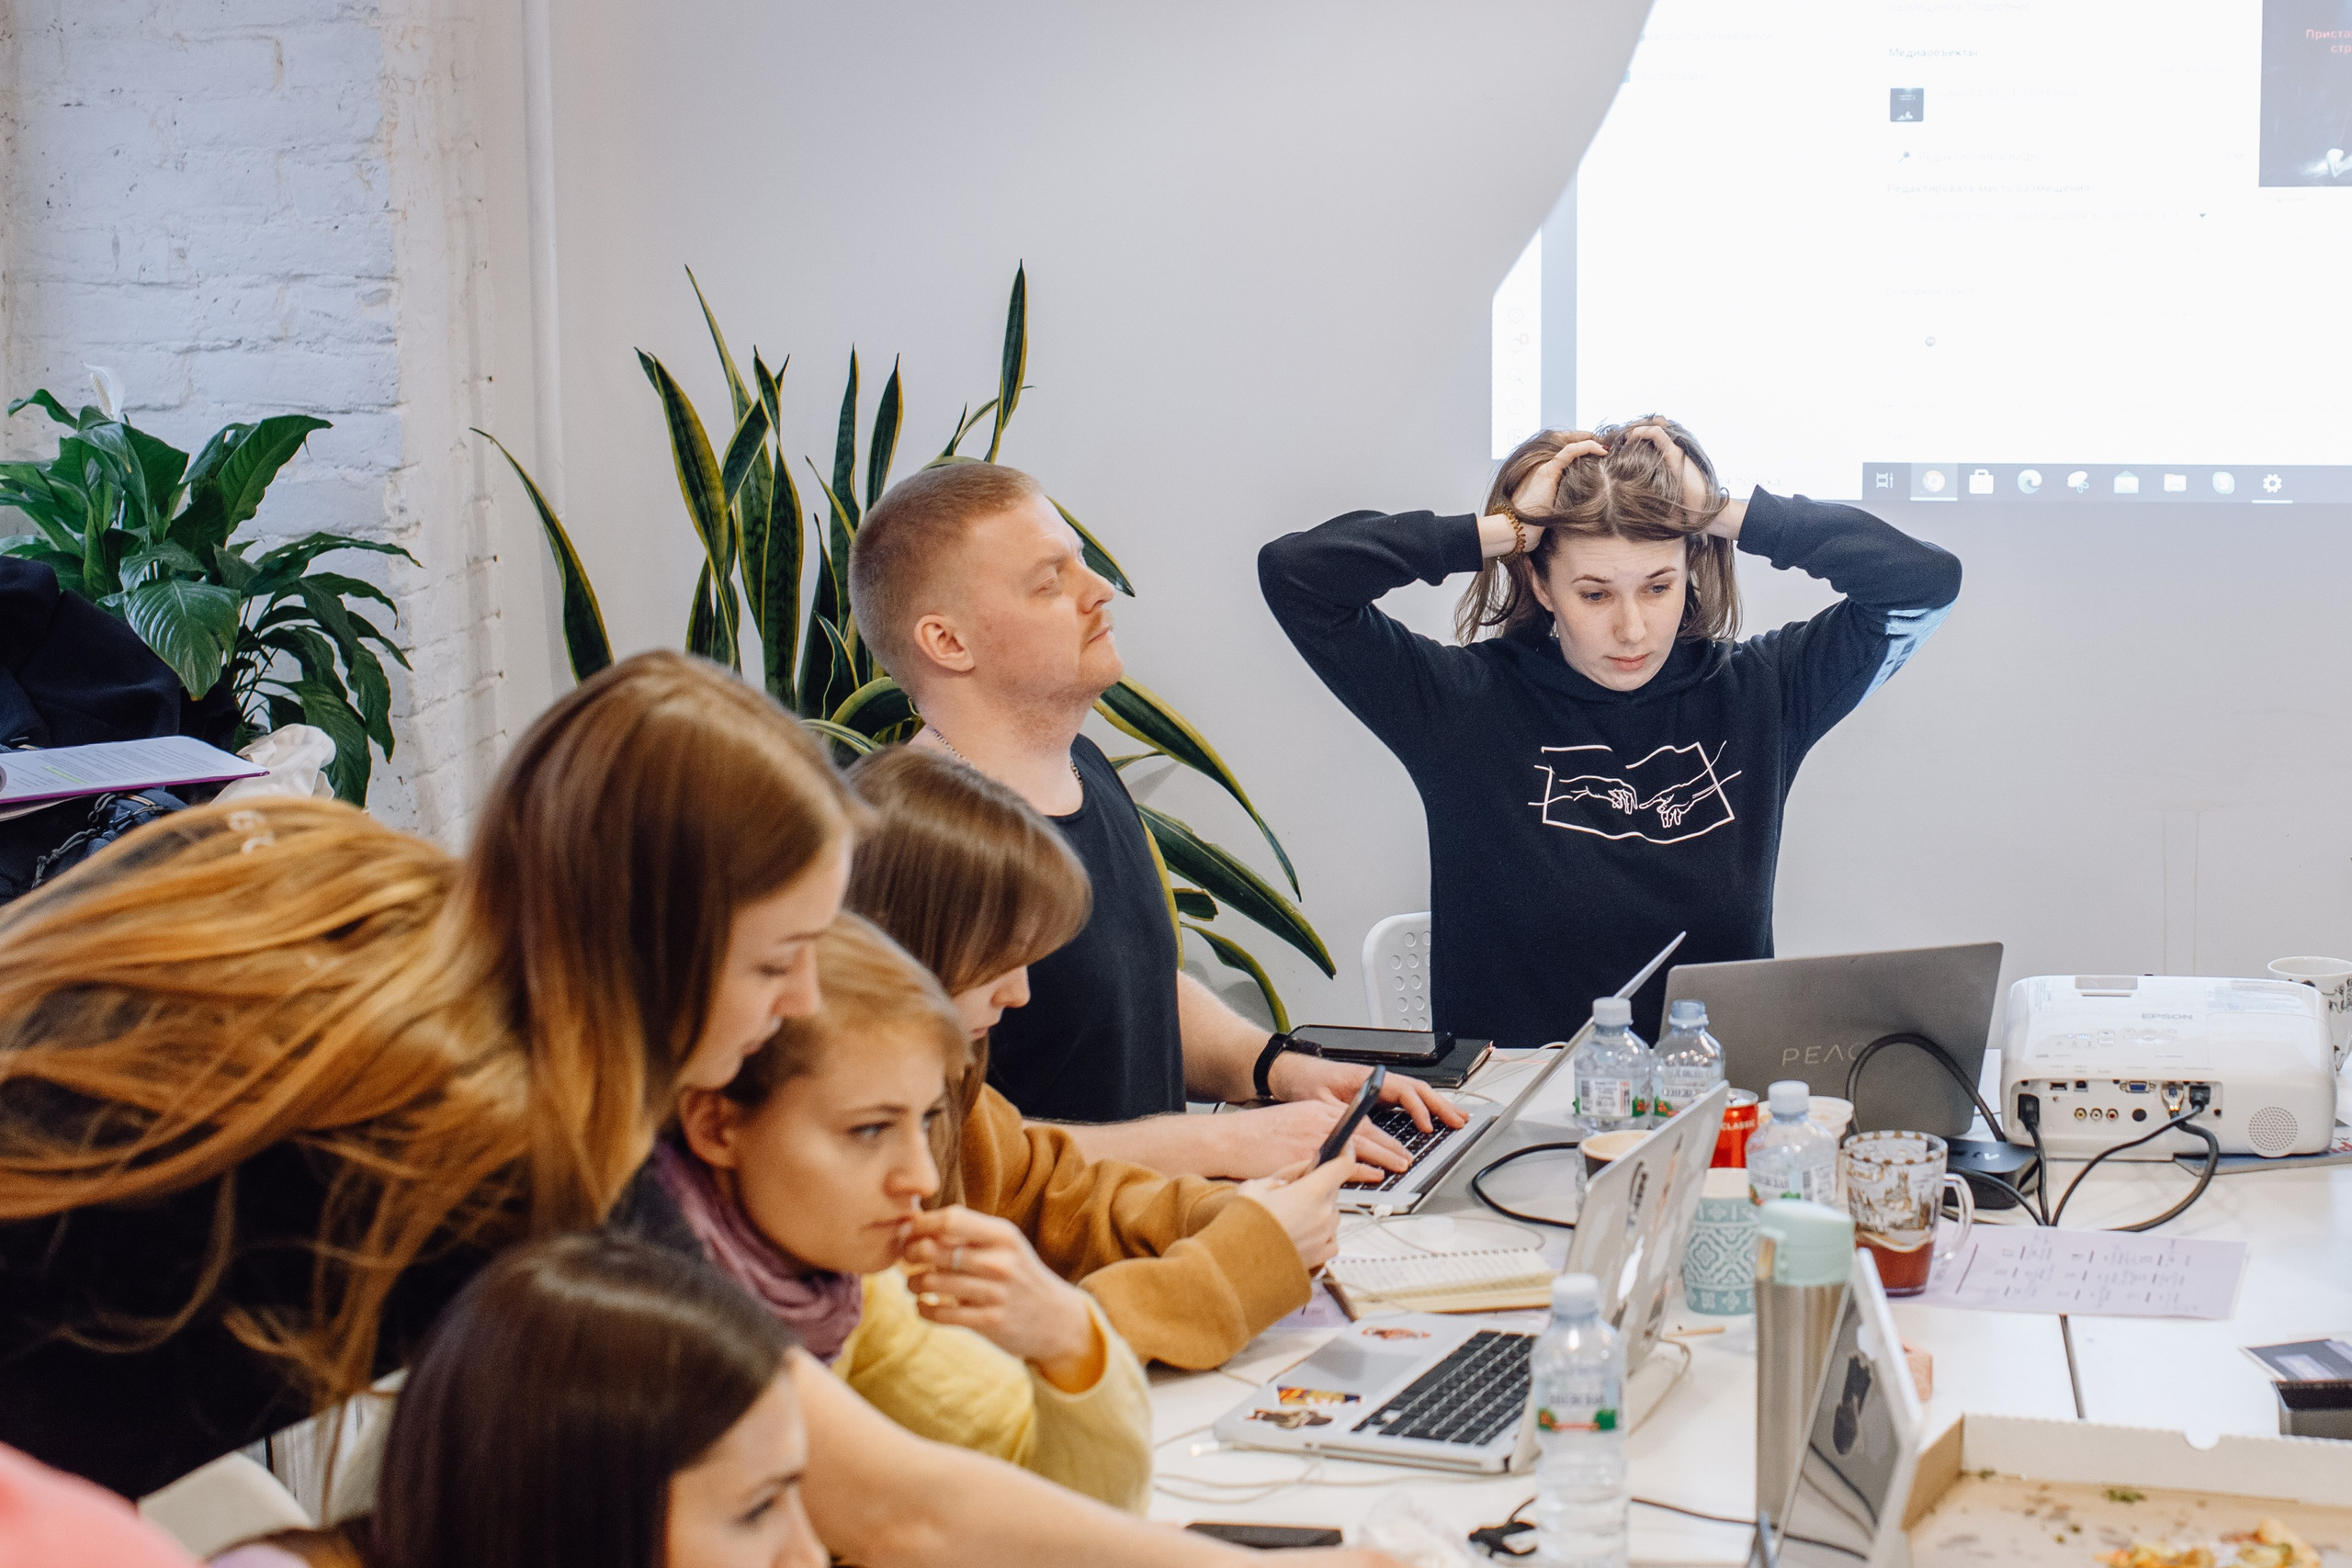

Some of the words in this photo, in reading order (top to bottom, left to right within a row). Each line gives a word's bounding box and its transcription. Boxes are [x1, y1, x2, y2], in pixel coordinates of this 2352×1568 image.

[2306, 28, 2352, 40] Приста
[1888, 47, 1979, 58] Медиаобъекты
[2141, 1012, 2193, 1021] EPSON
